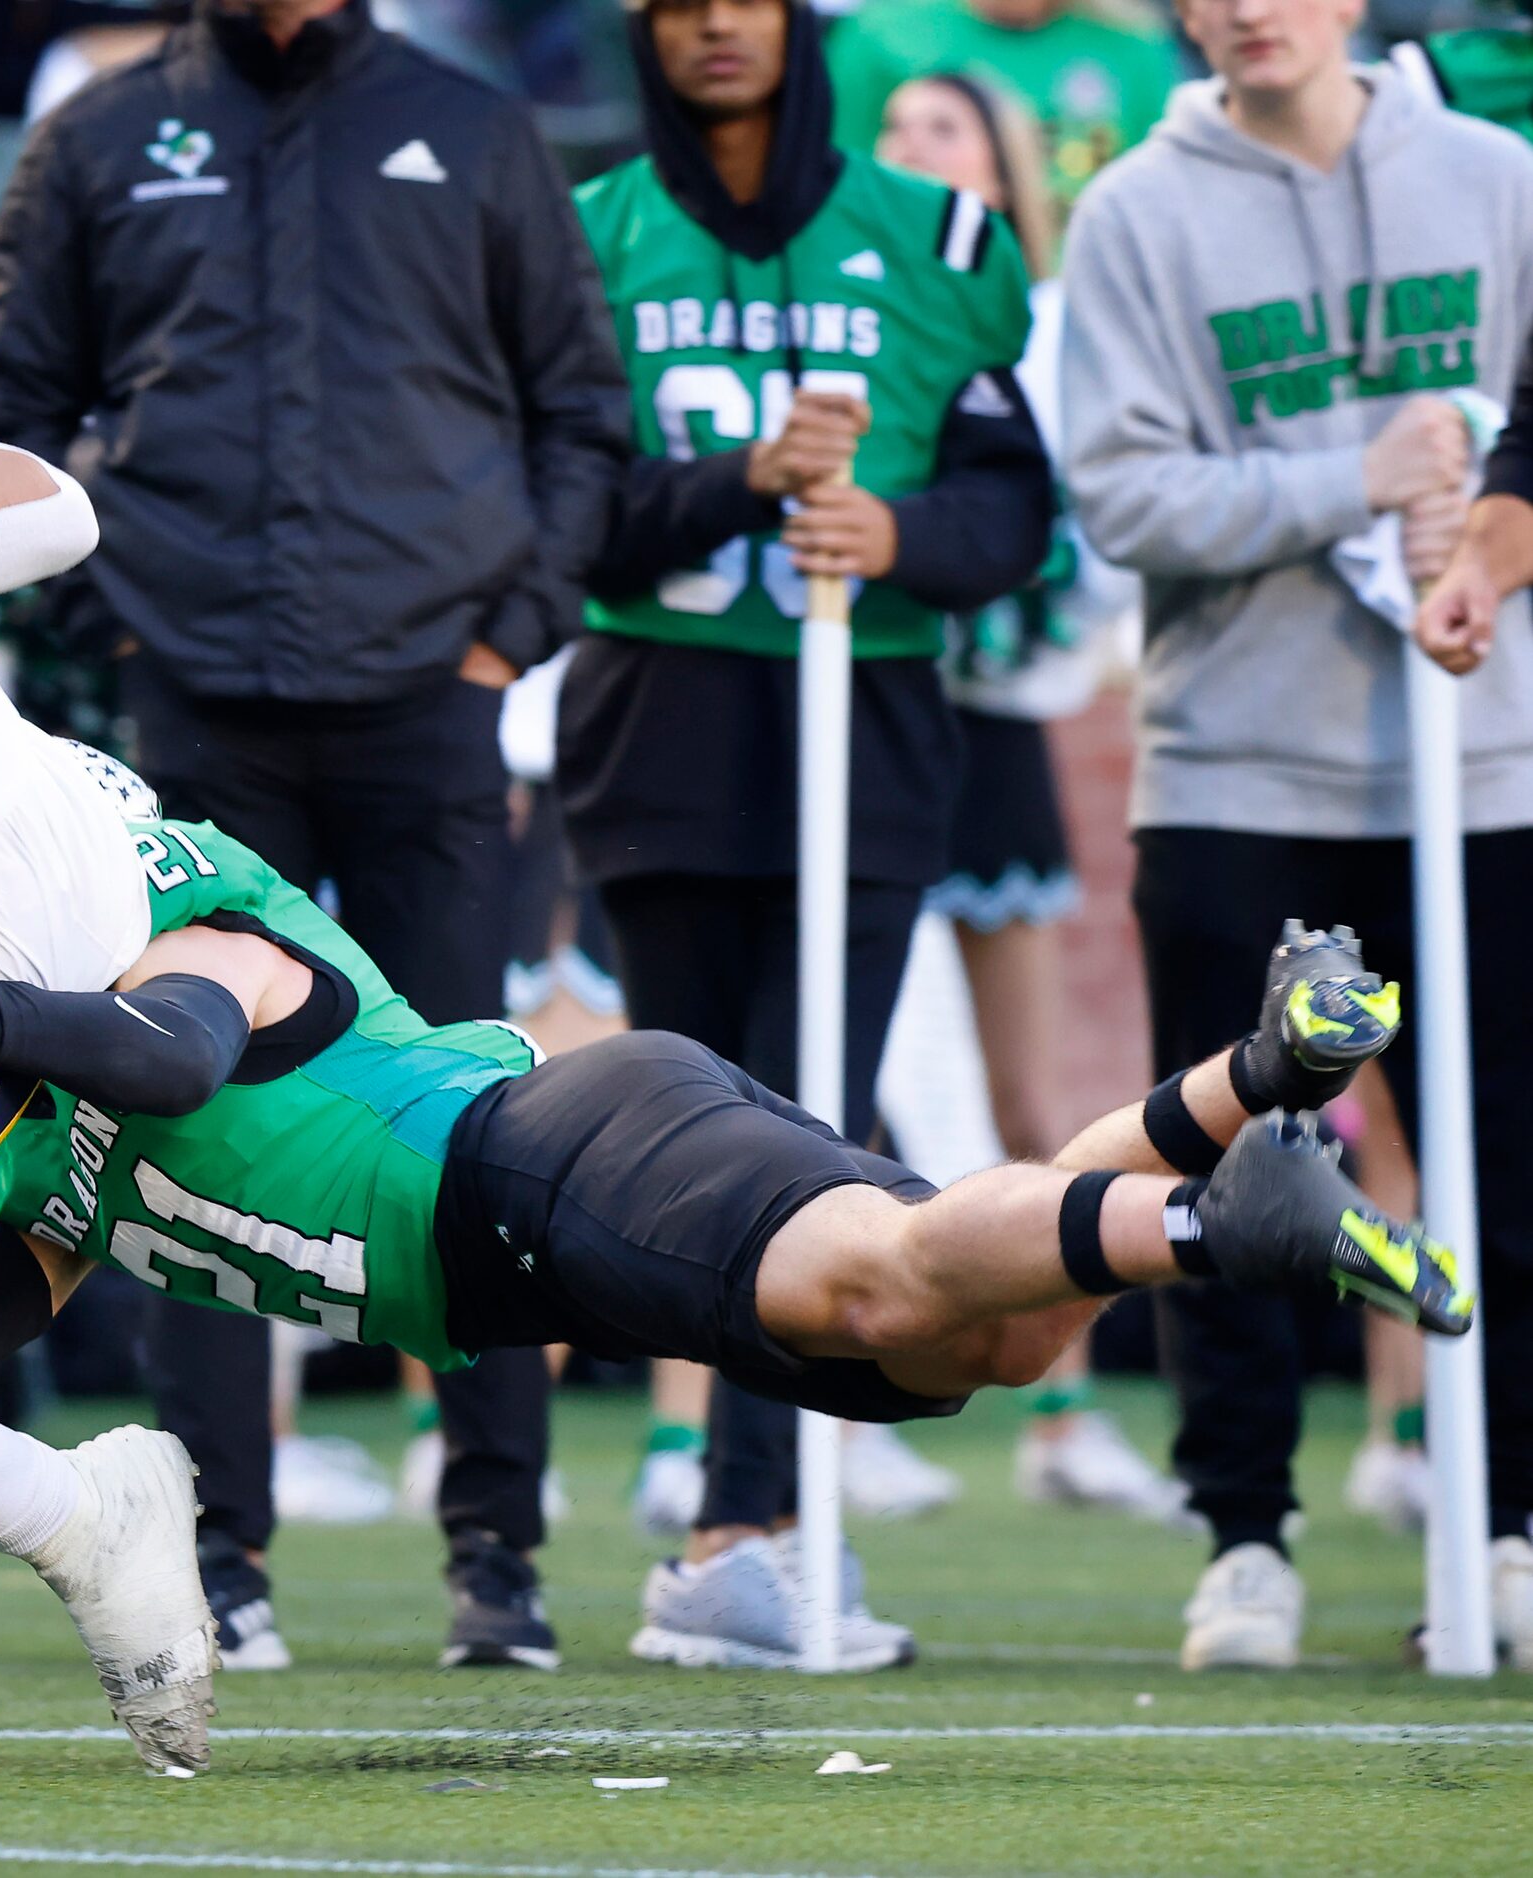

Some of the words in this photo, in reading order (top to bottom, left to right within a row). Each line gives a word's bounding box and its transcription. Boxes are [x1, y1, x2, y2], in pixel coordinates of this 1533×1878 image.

[634, 297, 881, 358] DRAGONS
[132, 826, 219, 895] 21
[110, 1159, 367, 1345] 21
